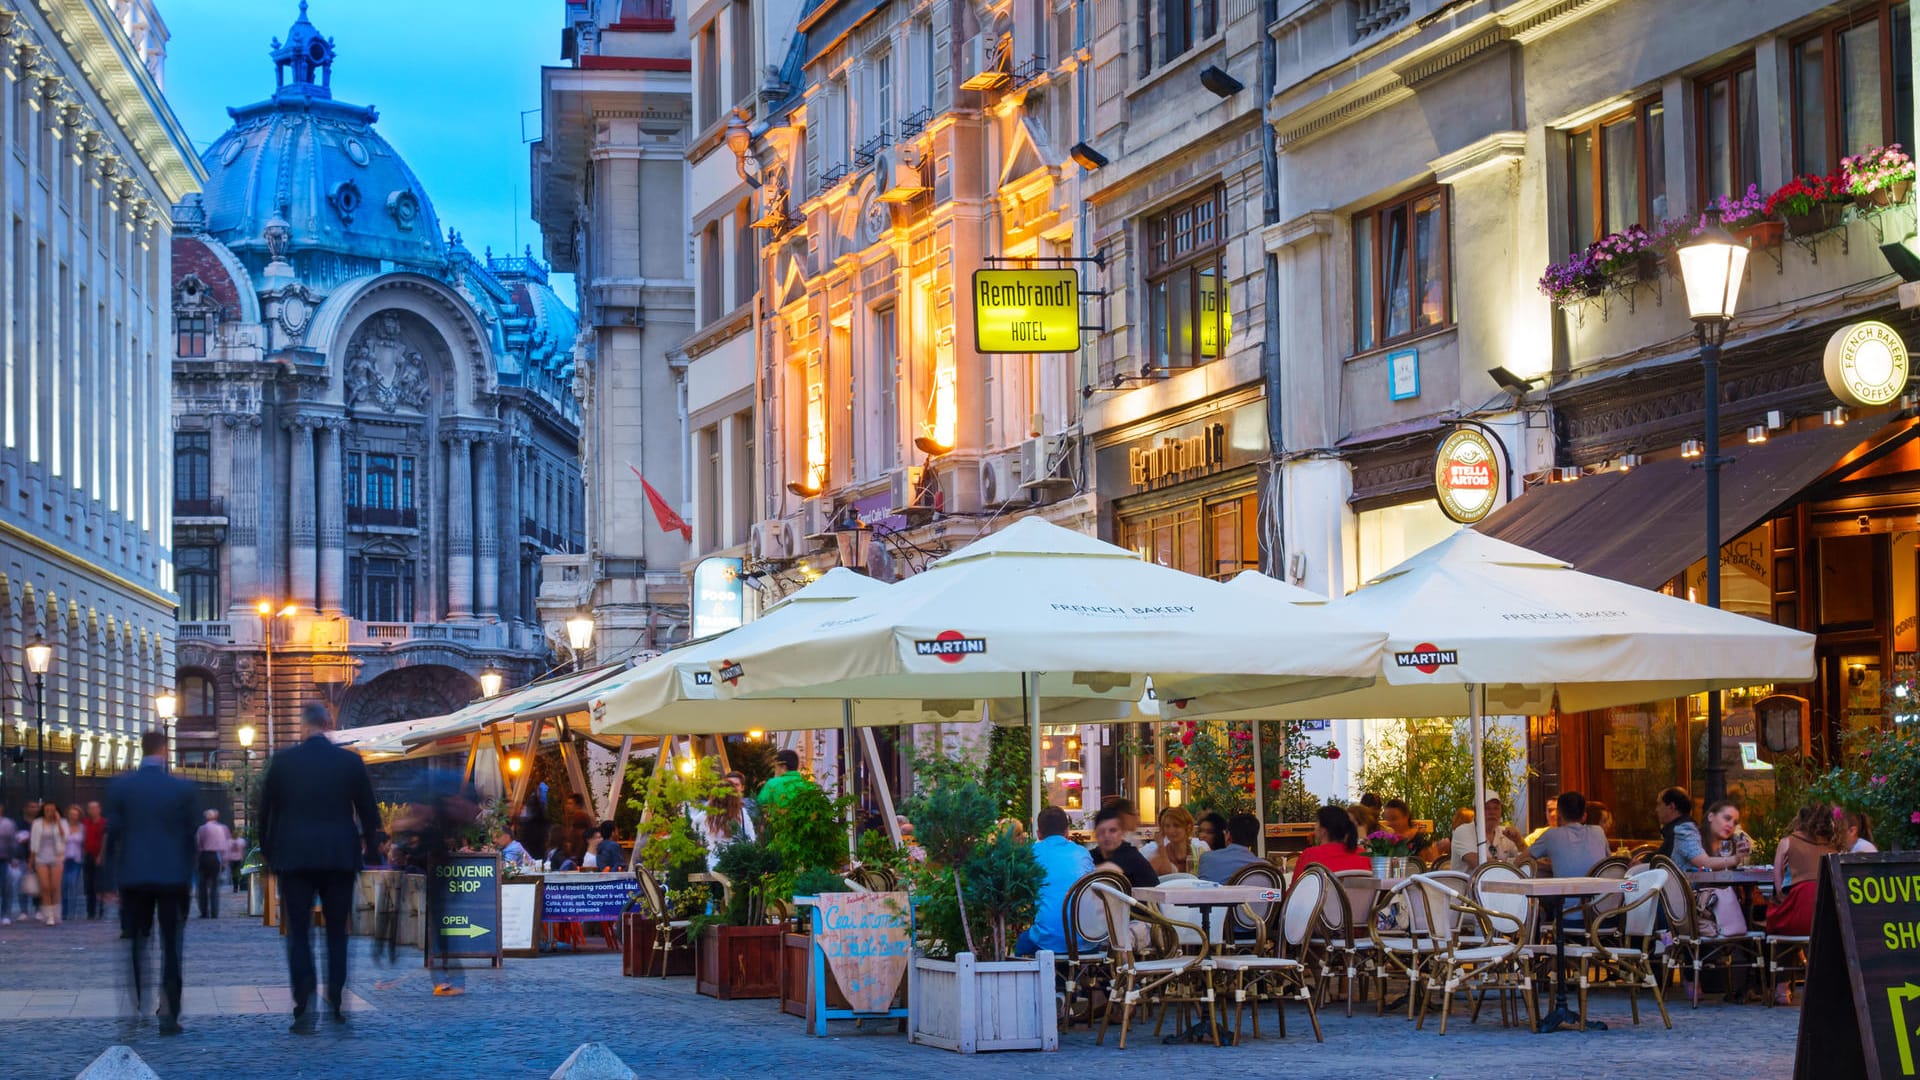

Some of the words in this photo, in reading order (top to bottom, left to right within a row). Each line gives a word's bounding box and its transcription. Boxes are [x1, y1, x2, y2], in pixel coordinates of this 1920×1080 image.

[1011, 321, 1047, 341] HOTEL
[1845, 328, 1873, 369] FRENCH
[1877, 329, 1904, 370] BAKERY
[1854, 381, 1896, 399] COFFEE
[1450, 466, 1489, 476] STELLA
[1450, 476, 1490, 486] ARTOIS
[701, 591, 736, 601] FOOD
[1050, 603, 1126, 614] FRENCH
[1132, 606, 1195, 614] BAKERY
[1502, 612, 1572, 621] FRENCH
[1576, 610, 1627, 619] BAKERY
[917, 640, 984, 654] MARTINI
[1398, 652, 1455, 665] MARTINI
[435, 865, 494, 877] SOUVENIR
[449, 881, 481, 893] SHOP
[442, 916, 469, 925] OPEN
[1883, 922, 1920, 950] SH
